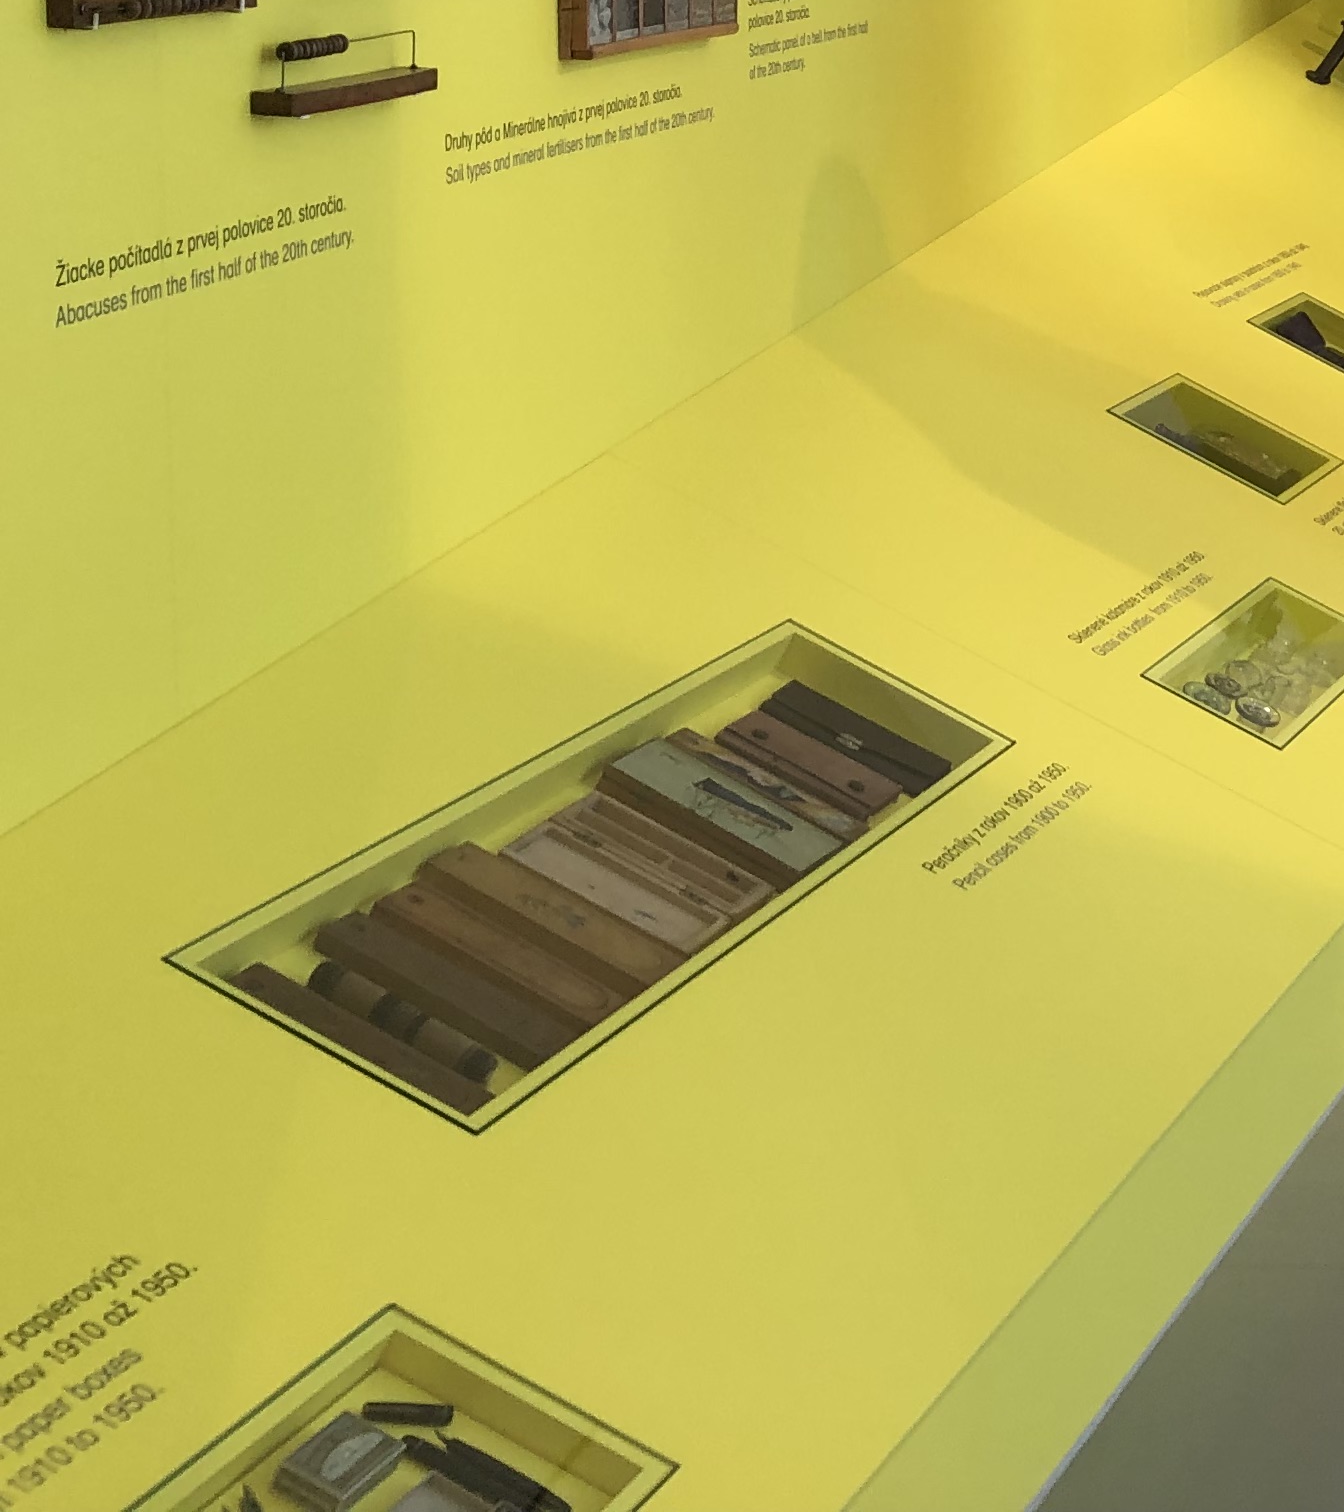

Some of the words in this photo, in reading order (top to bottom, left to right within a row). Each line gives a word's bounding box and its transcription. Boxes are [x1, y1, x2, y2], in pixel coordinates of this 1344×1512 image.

[55, 257, 104, 287] Žiacke
[108, 236, 172, 278] počítadlá
[176, 239, 184, 255] z
[187, 224, 219, 257] prvej
[222, 214, 273, 248] polovice
[276, 206, 295, 228] 20.
[298, 194, 346, 222] storočia.
[55, 293, 127, 328] Abacuses
[131, 283, 162, 306] from
[165, 275, 187, 296] the
[190, 265, 214, 289] first
[217, 255, 241, 281] half
[244, 251, 256, 274] of
[259, 249, 279, 269] the
[281, 239, 308, 263] 20th
[310, 230, 354, 254] century.
[3, 1254, 140, 1351] papierových
[42, 1320, 106, 1364] 1910
[102, 1299, 138, 1326] až
[131, 1262, 198, 1302] 1950.
[7, 1445, 73, 1492] 1910
[64, 1428, 100, 1451] to
[92, 1383, 164, 1429] 1950.
